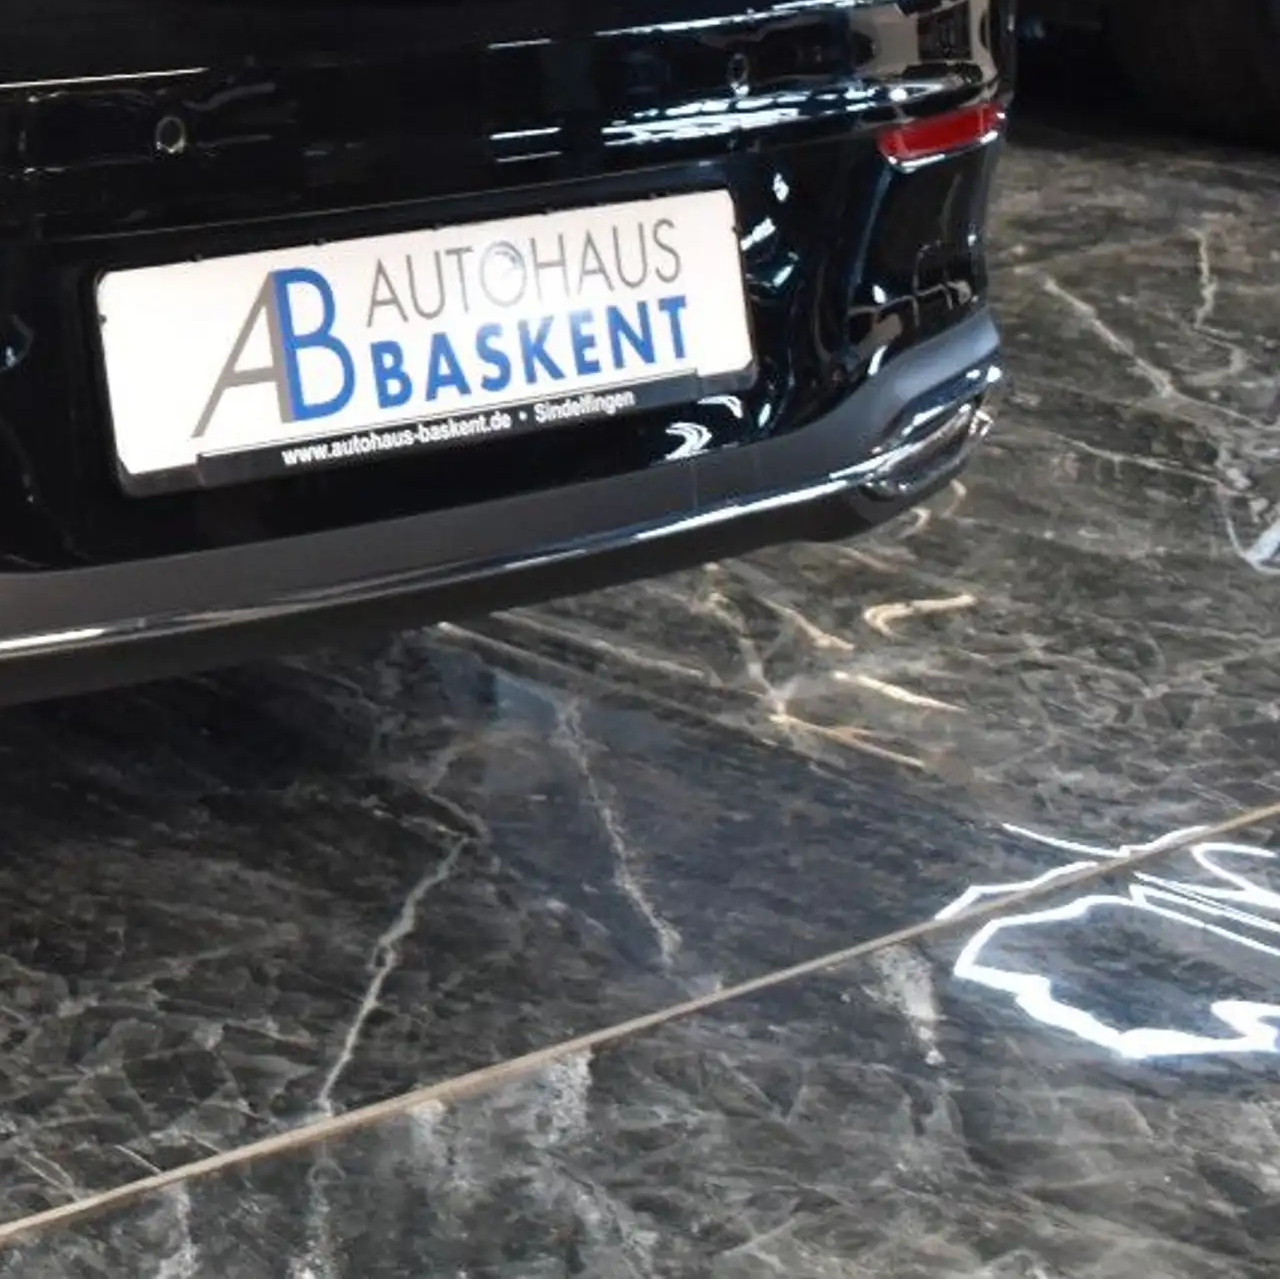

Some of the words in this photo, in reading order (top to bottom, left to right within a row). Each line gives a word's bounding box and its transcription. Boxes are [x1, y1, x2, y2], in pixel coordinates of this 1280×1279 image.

[366, 218, 682, 327] AUTOHAUS
[191, 267, 356, 439] AB
[370, 295, 688, 409] BASKENT
[281, 411, 512, 465] www.autohaus-baskent.de
[533, 390, 636, 423] Sindelfingen
